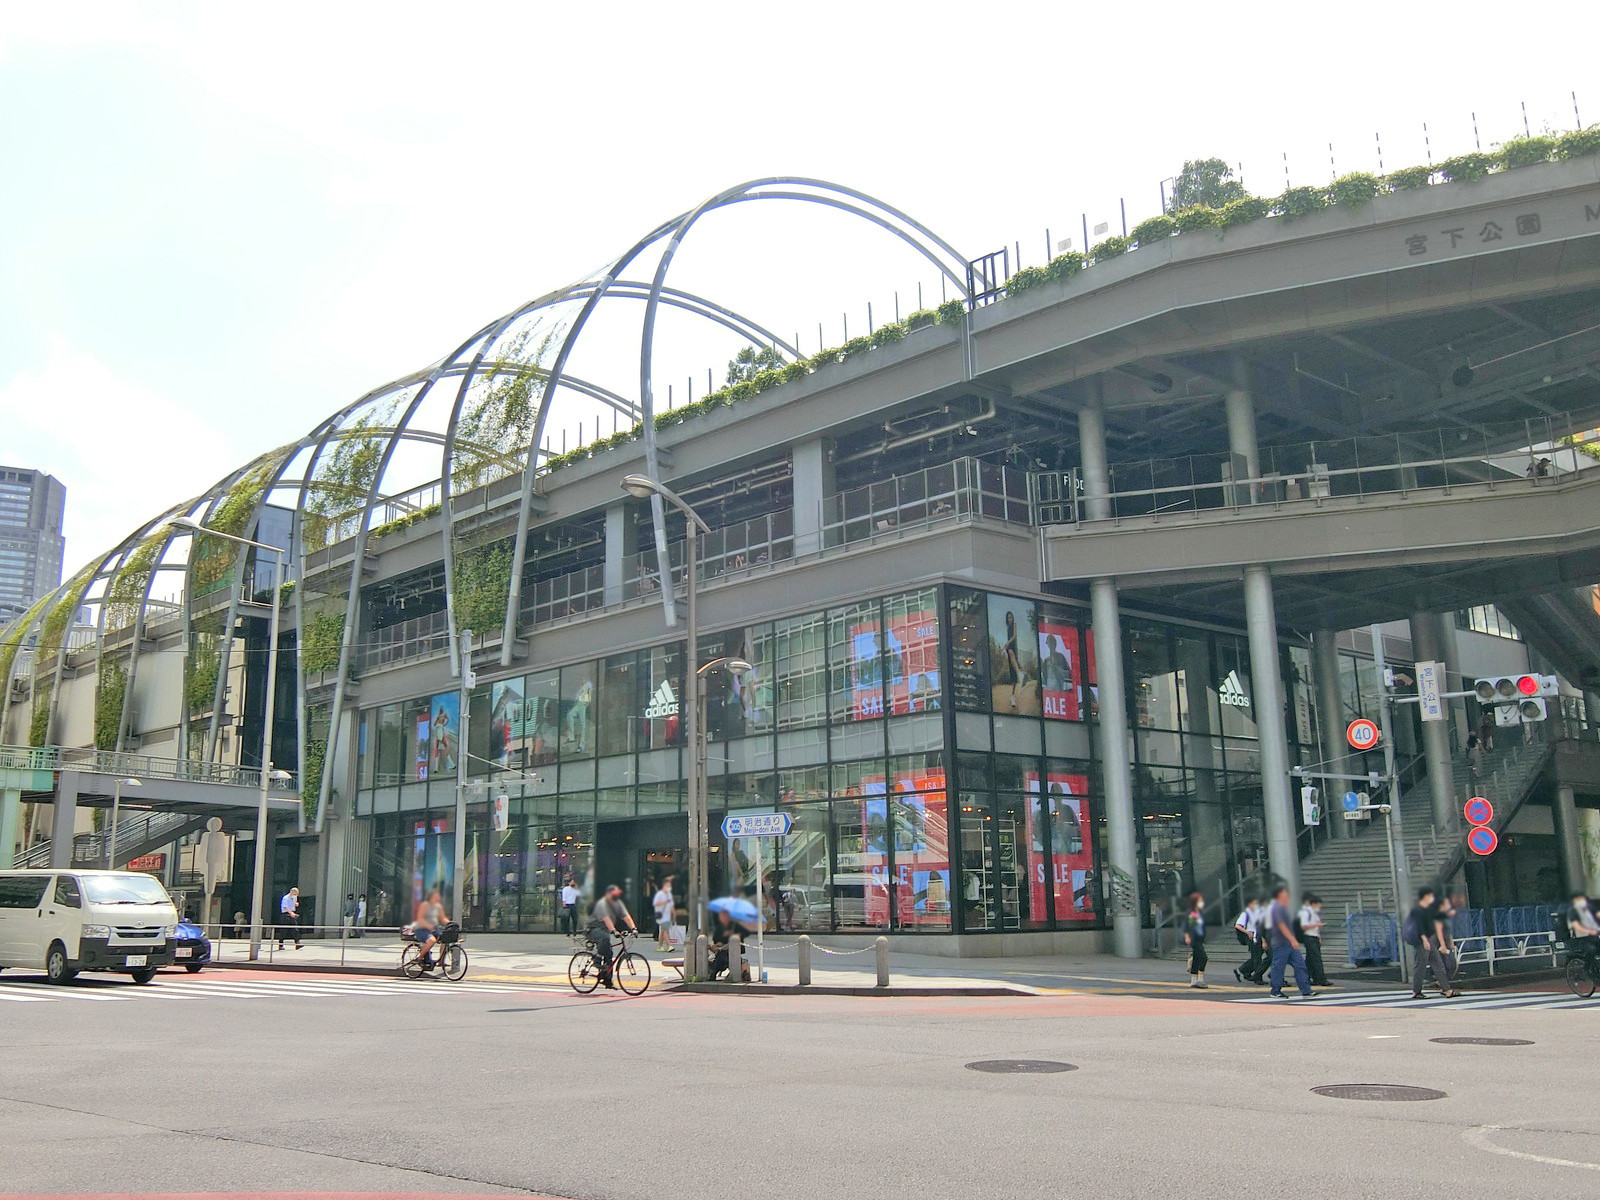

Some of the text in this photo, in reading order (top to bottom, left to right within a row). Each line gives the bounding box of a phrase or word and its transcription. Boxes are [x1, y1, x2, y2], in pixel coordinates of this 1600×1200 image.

[1405, 213, 1541, 256] 宮下公園
[916, 625, 934, 637] SALE
[1424, 667, 1438, 714] 宮下公園
[1044, 696, 1067, 716] ALE
[1355, 727, 1371, 741] 40
[731, 822, 741, 831] 305
[745, 816, 780, 827] 明治通り
[1037, 863, 1069, 884] SLE
